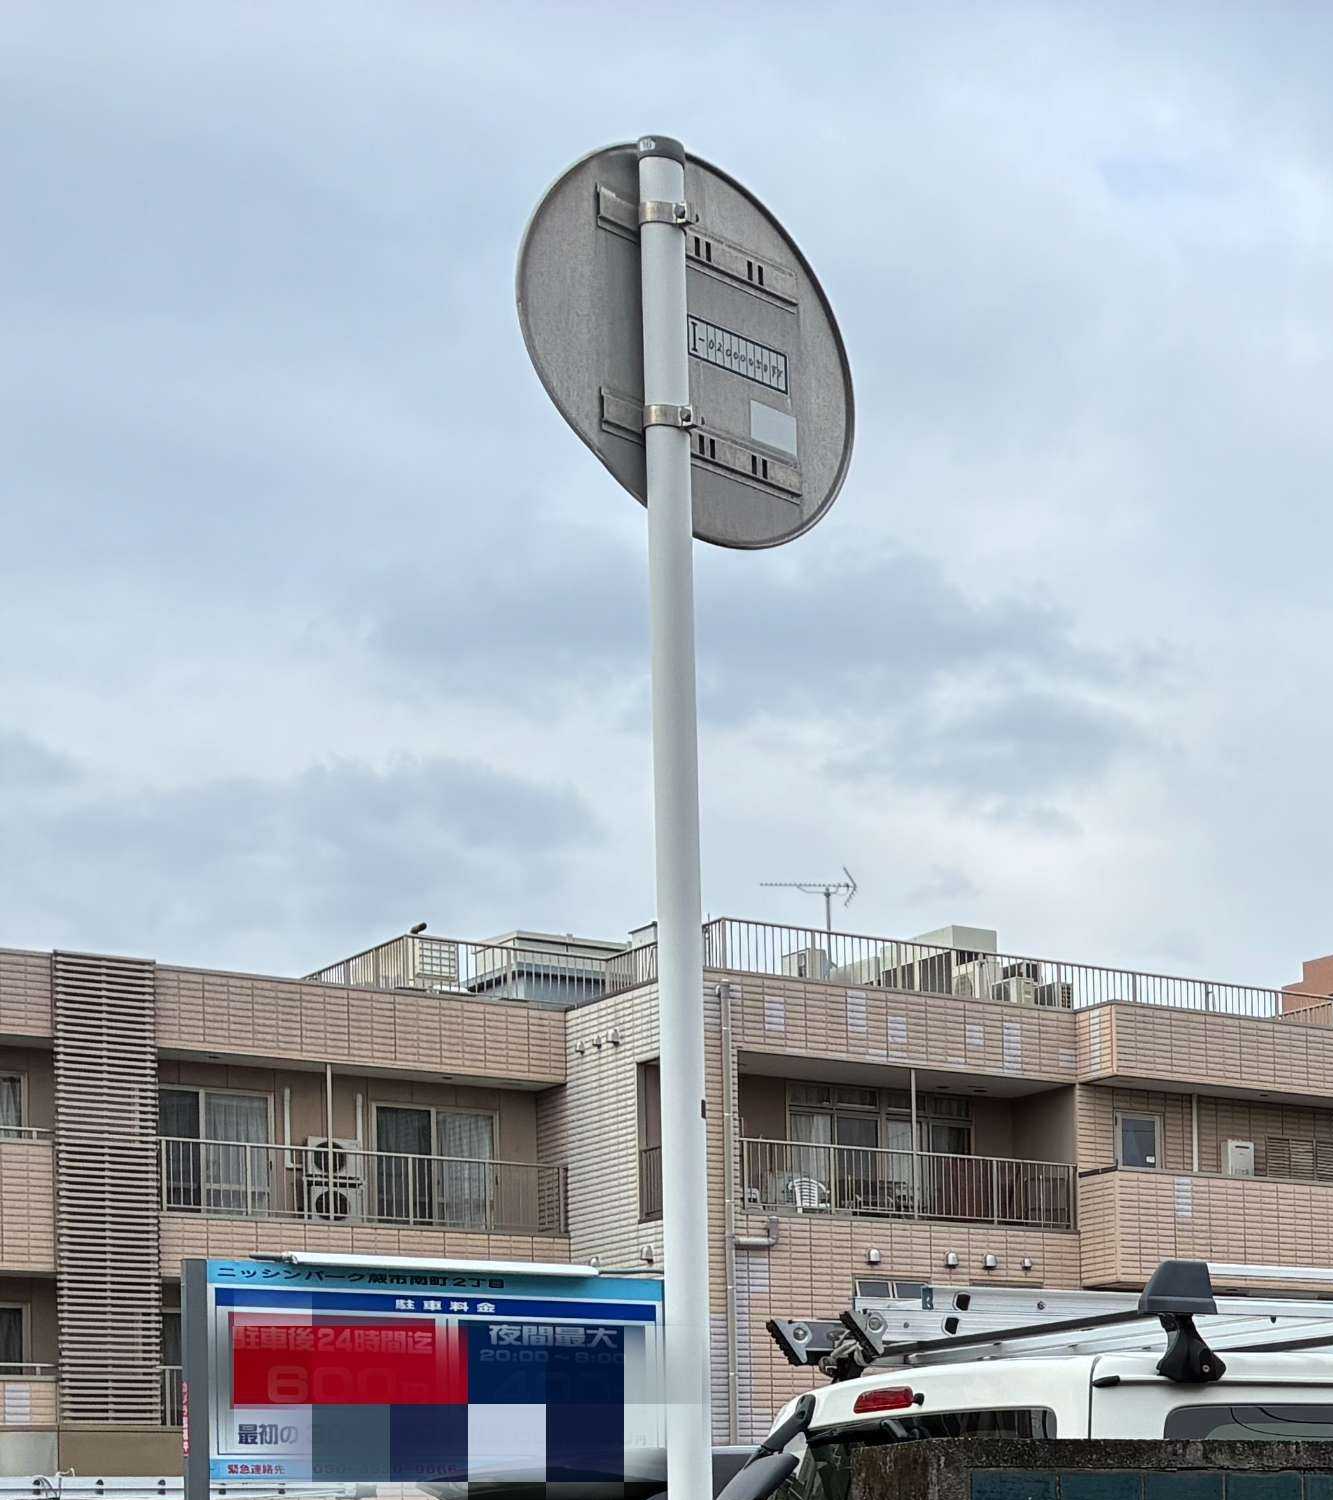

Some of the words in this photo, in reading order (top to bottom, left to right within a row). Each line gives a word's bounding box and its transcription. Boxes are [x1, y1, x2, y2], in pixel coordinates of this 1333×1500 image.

[395, 1299, 496, 1313] 駐車料金
[489, 1323, 618, 1348] 夜間最大
